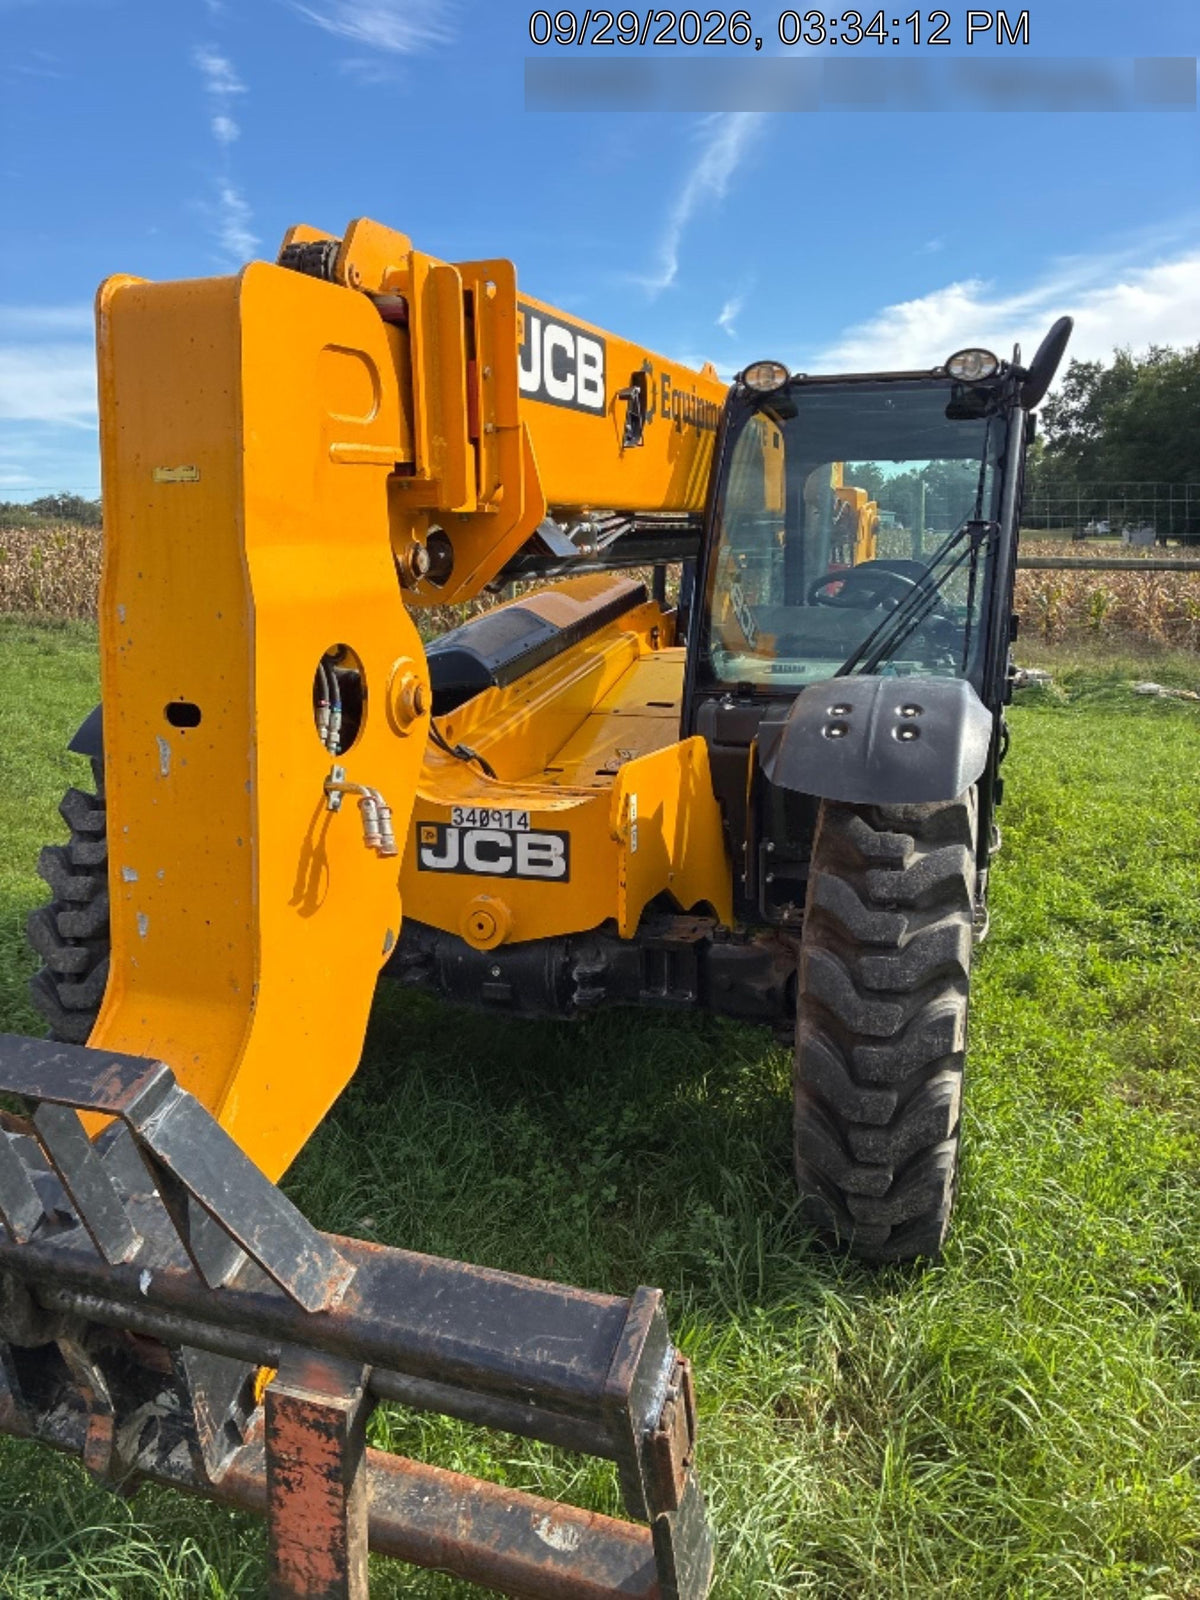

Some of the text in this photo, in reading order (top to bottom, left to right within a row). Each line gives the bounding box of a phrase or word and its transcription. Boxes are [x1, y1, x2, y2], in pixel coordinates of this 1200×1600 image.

[518, 315, 604, 409] JCB
[452, 807, 529, 829] 340914
[420, 827, 567, 878] JCB
